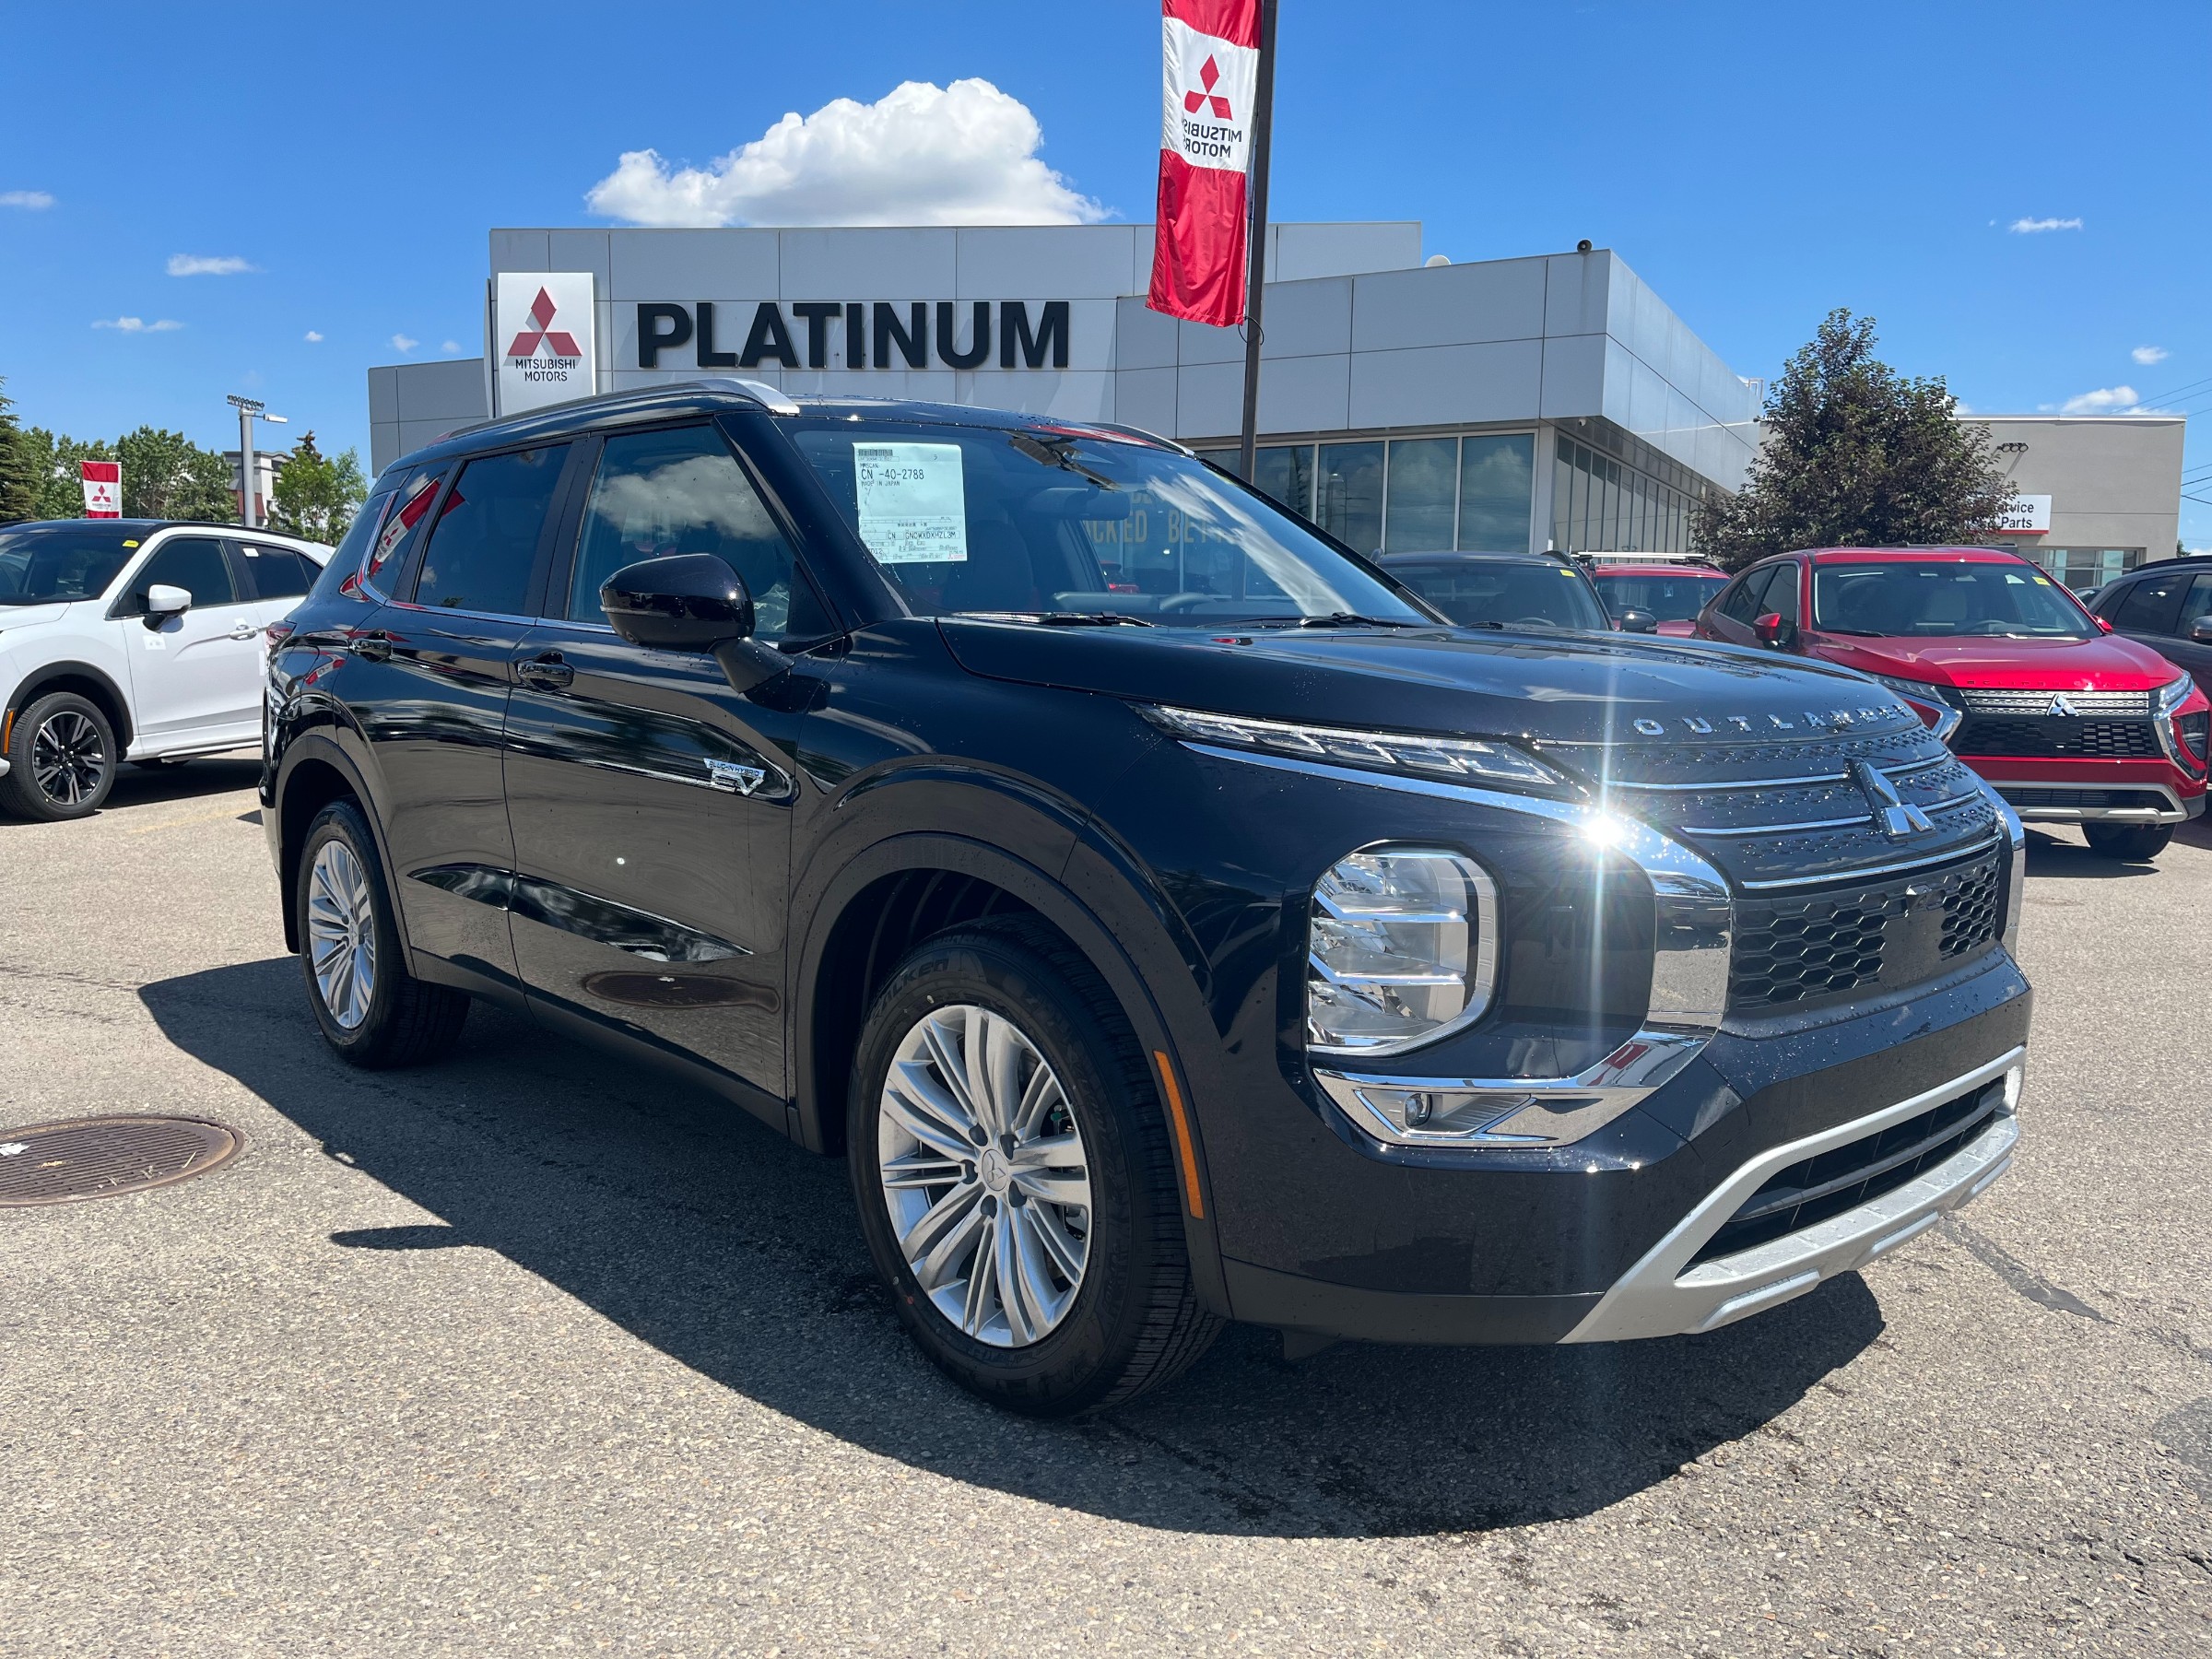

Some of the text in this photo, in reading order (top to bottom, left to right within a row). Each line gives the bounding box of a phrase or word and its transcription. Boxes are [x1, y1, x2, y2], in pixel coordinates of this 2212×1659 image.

[637, 300, 1070, 370] PLATINUM
[515, 359, 576, 370] MITSUBISHI
[524, 371, 568, 382] MOTORS
[861, 468, 924, 479] CN -40-2788
[2001, 516, 2033, 529] Parts
